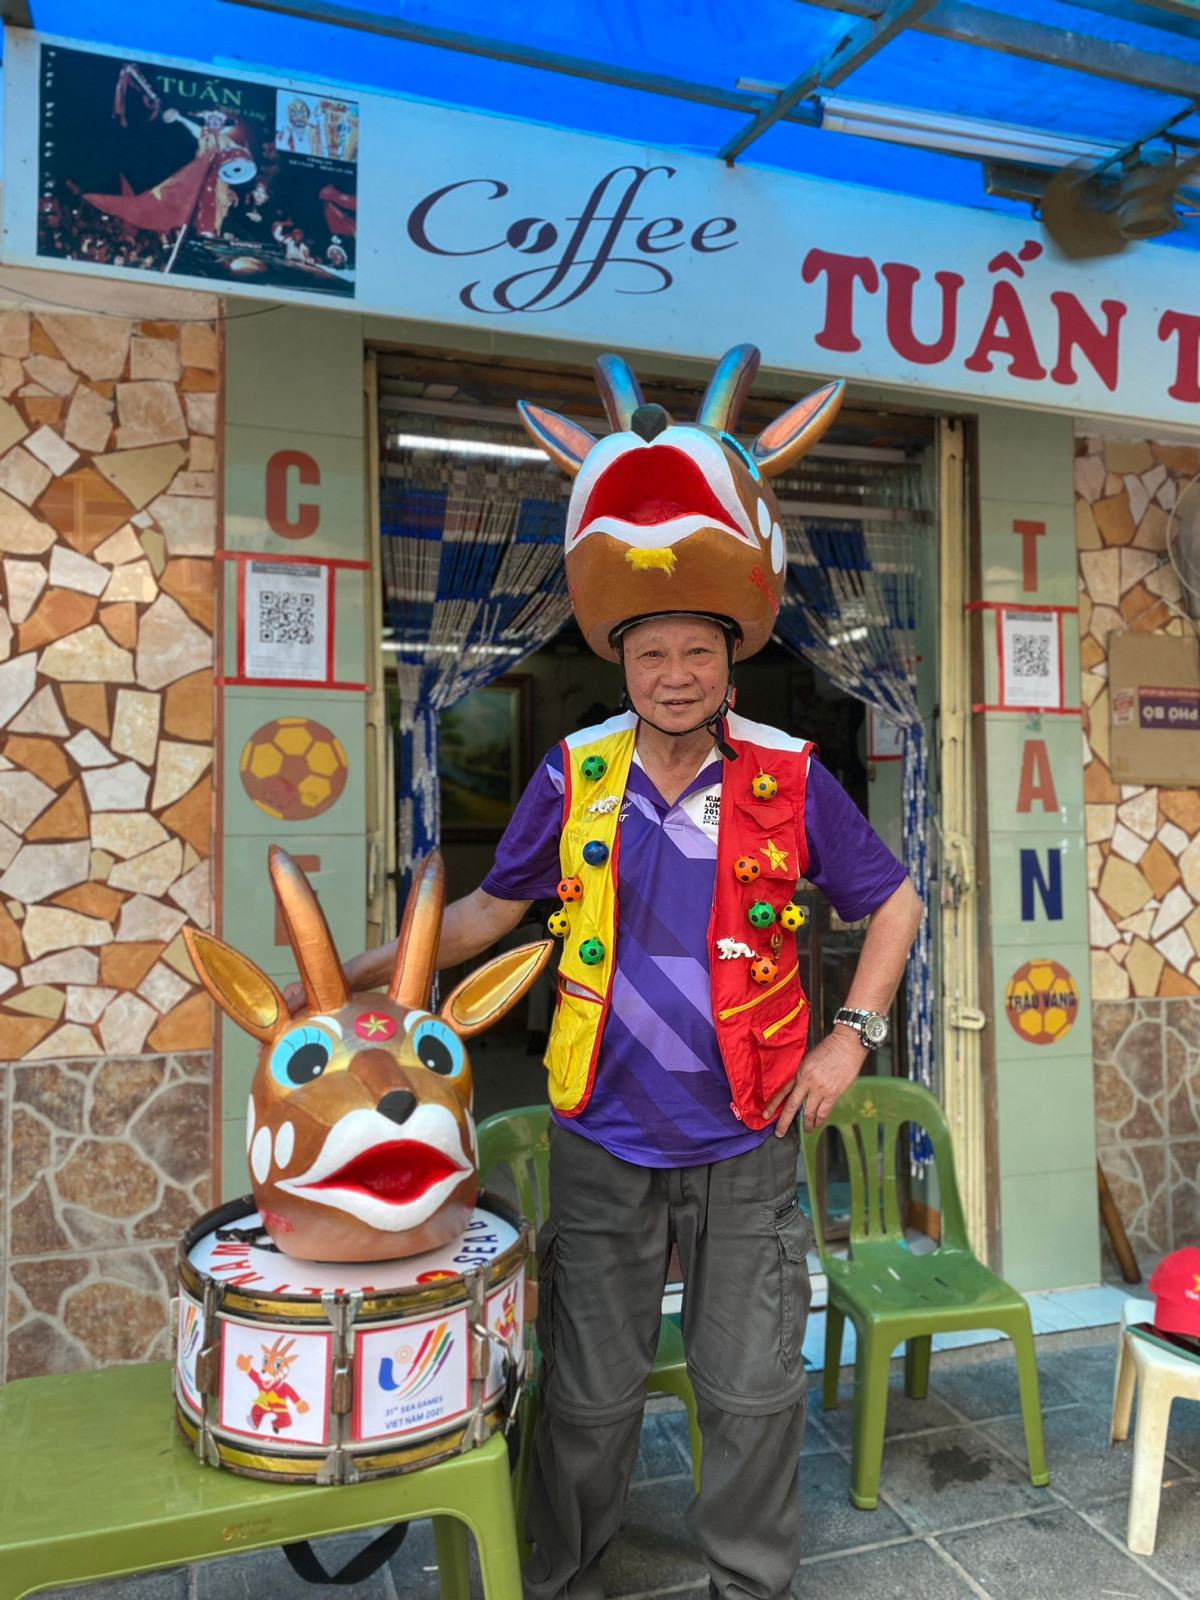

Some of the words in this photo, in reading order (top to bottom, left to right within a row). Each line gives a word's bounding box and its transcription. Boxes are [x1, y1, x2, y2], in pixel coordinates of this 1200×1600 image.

[156, 75, 242, 106] TUẤN
[407, 165, 740, 315] Coffee
[801, 239, 1127, 392] TUẤN
[265, 449, 321, 540] C
[452, 1233, 498, 1266] SEA
[384, 1417, 403, 1430] VIET
[405, 1412, 425, 1425] NAM
[401, 1403, 416, 1414] SEA
[417, 1396, 443, 1408] GAMES
